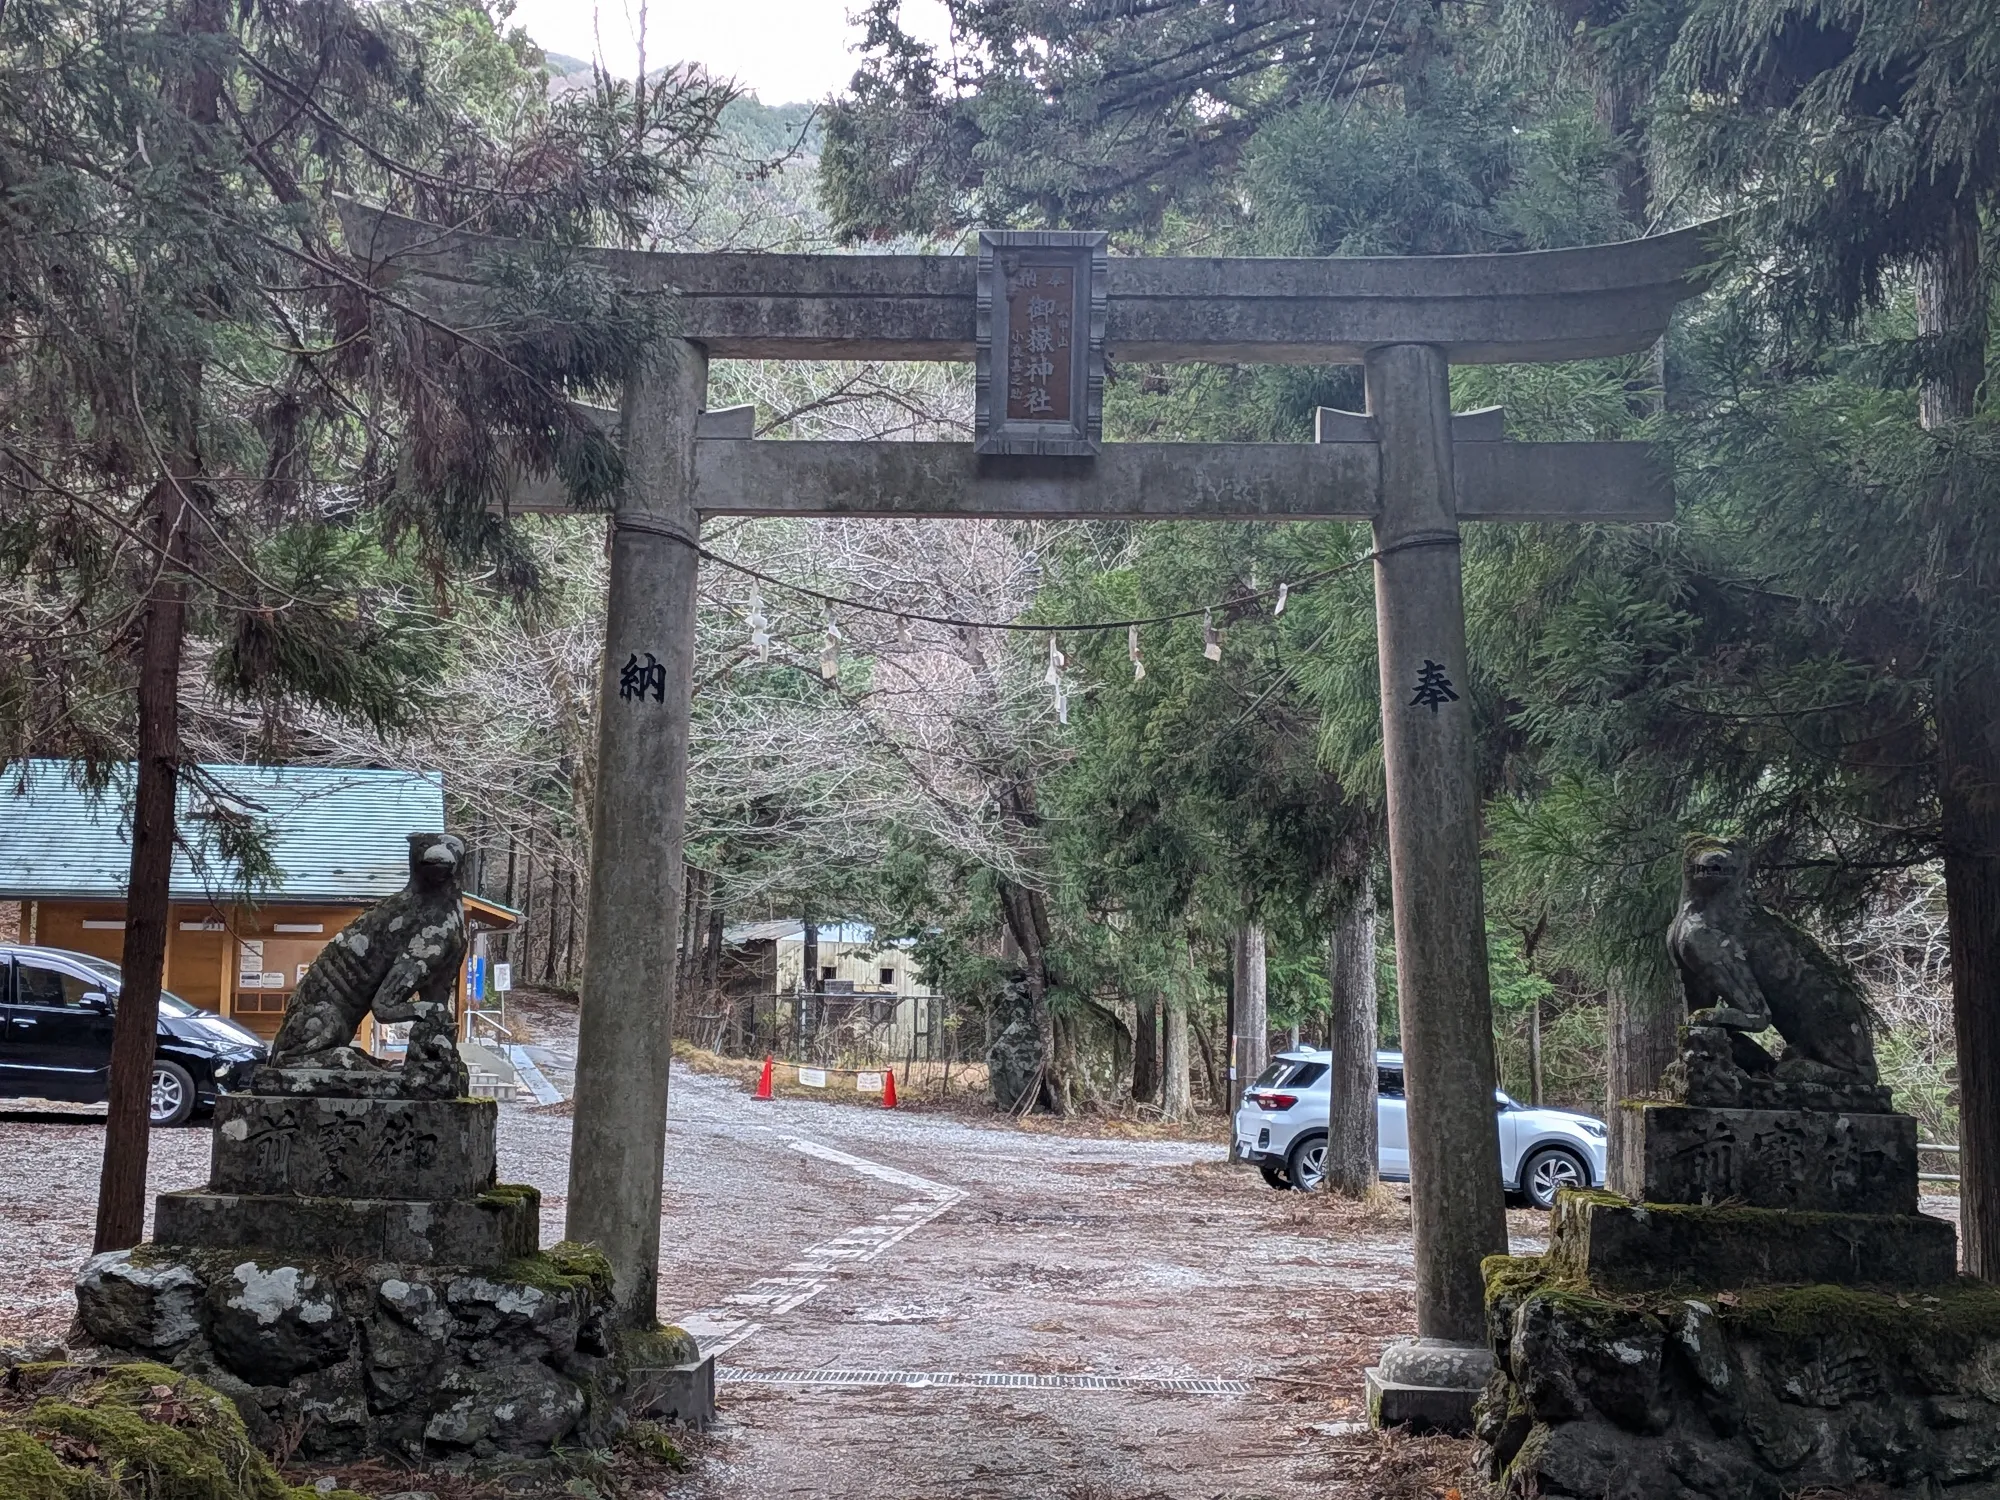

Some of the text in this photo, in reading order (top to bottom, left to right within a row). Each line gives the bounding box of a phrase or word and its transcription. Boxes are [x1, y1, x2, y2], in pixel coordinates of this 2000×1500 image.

[1024, 295, 1057, 414] 御嶽神社
[619, 652, 667, 704] 納
[1408, 659, 1460, 715] 奉
